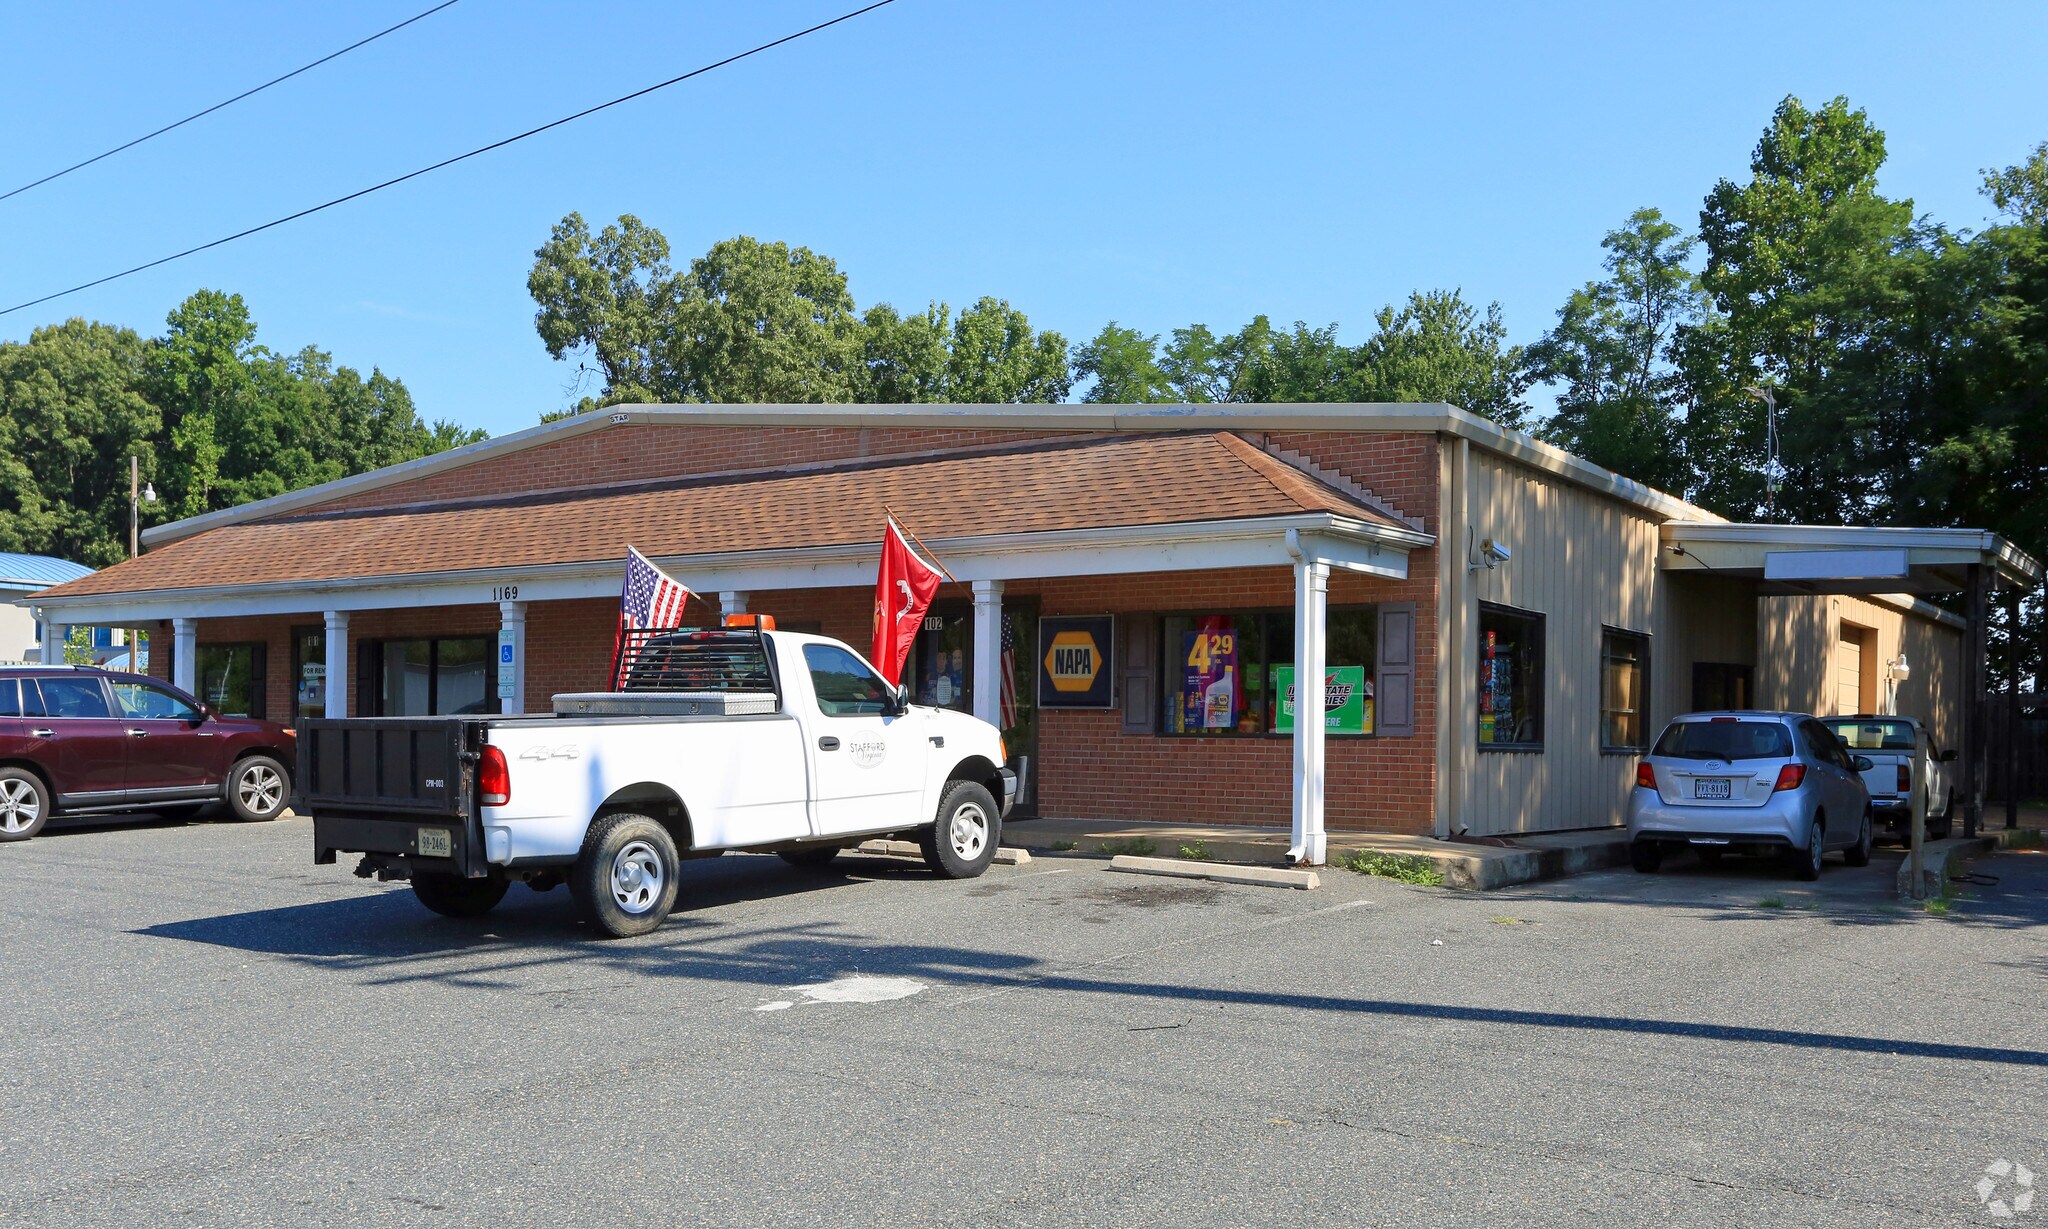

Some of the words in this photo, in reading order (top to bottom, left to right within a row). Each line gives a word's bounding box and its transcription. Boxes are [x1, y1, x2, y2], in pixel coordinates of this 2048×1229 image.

[493, 586, 518, 601] 1169
[925, 616, 942, 630] 102
[1055, 648, 1092, 675] NAPA
[304, 667, 315, 675] FOR
[315, 667, 326, 675] REN
[1323, 718, 1341, 727] ERE
[850, 742, 886, 752] STAFFORD
